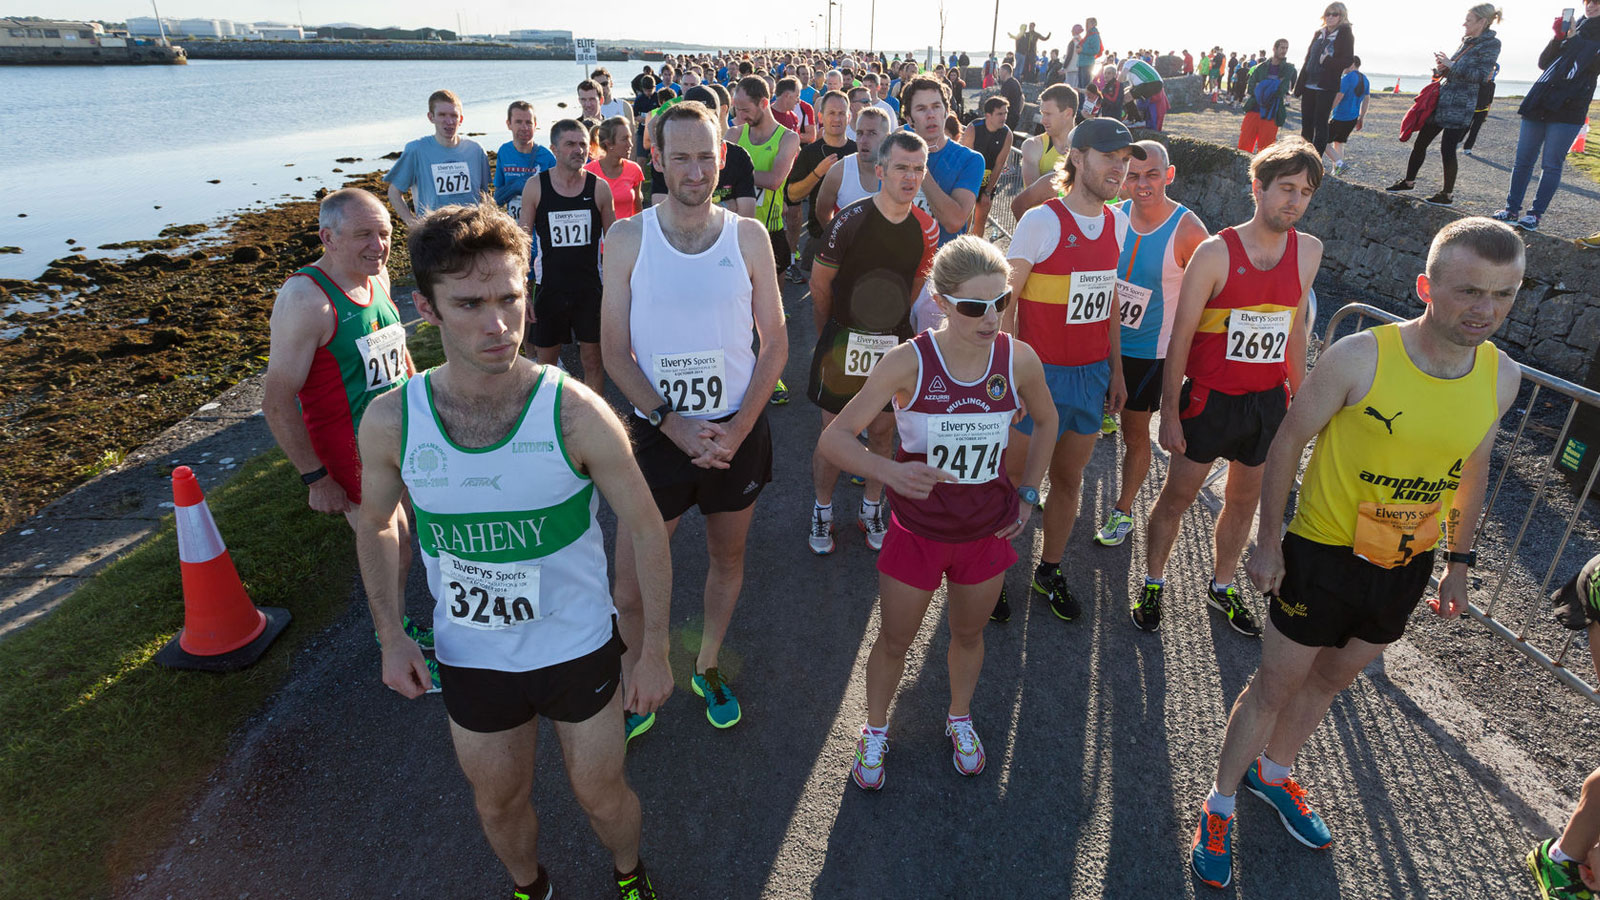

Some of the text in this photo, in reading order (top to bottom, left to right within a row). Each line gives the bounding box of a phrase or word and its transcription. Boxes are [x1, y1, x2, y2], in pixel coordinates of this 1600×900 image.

[577, 39, 595, 48] ELITE
[436, 173, 470, 193] 2672
[553, 224, 589, 244] 3121
[1079, 273, 1102, 283] Elverys
[1070, 289, 1113, 321] 2691
[1240, 313, 1267, 323] Elverys
[856, 335, 879, 345] Elverys
[1230, 330, 1286, 360] 2692
[660, 357, 716, 369] Elverys Sports
[659, 375, 723, 412] 3259
[946, 397, 991, 414] MULLINGAR
[941, 421, 1000, 433] Elverys Sports
[932, 442, 1000, 479] 2474
[1375, 508, 1417, 521] Elverys
[427, 516, 547, 553] RAHENY
[1394, 534, 1415, 564] 5
[452, 560, 527, 581] Elverys Sports
[449, 581, 535, 625] 3240
